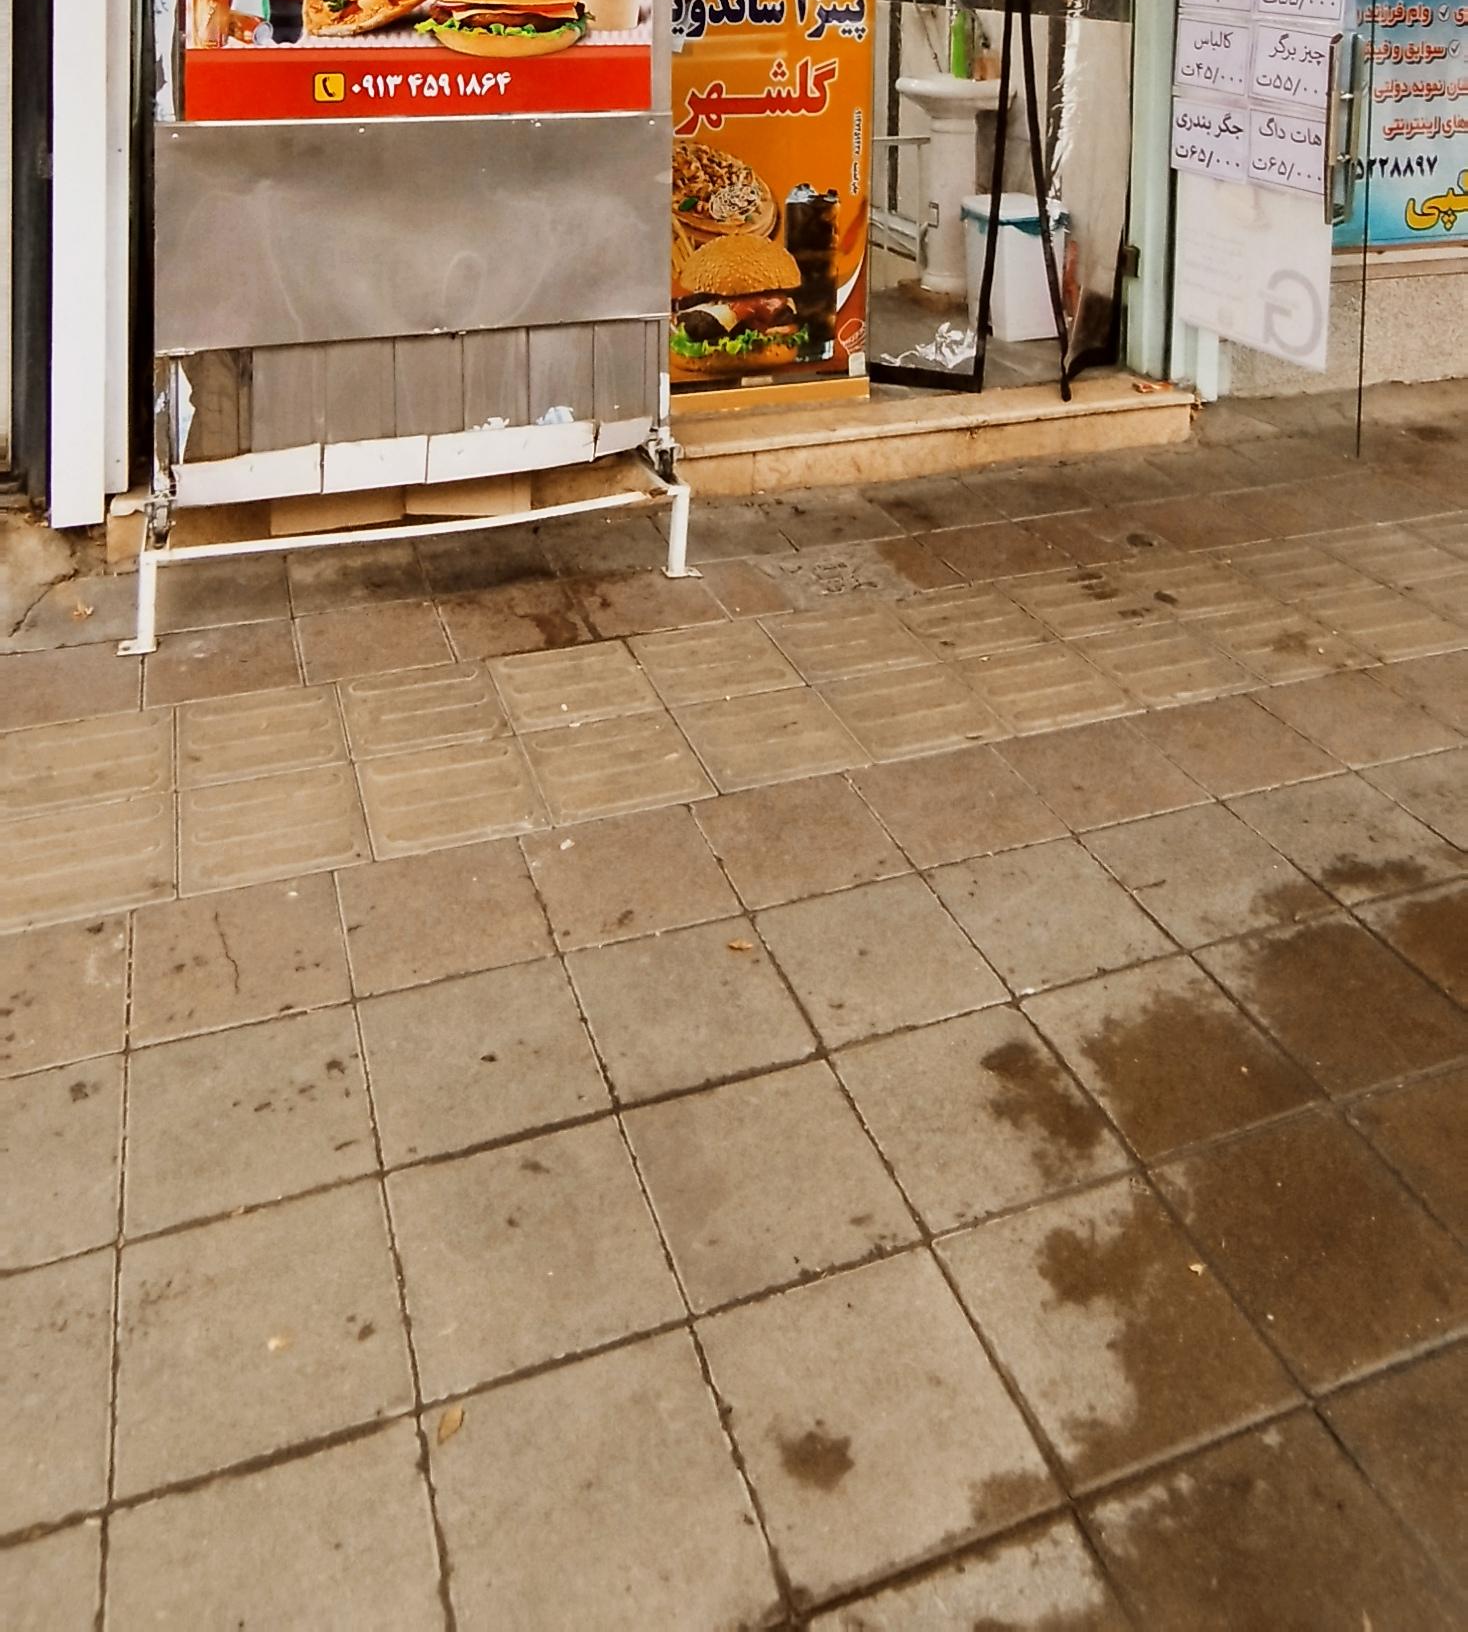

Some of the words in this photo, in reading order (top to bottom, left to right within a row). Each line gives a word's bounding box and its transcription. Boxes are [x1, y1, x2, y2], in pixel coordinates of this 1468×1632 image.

[1194, 31, 1234, 50] کالباس
[1268, 33, 1297, 61] برگر
[674, 56, 839, 136] گلشهر
[1175, 112, 1212, 136] بندری
[1214, 112, 1244, 140] جگر
[1258, 117, 1287, 140] داگ
[1290, 127, 1323, 147] هات
